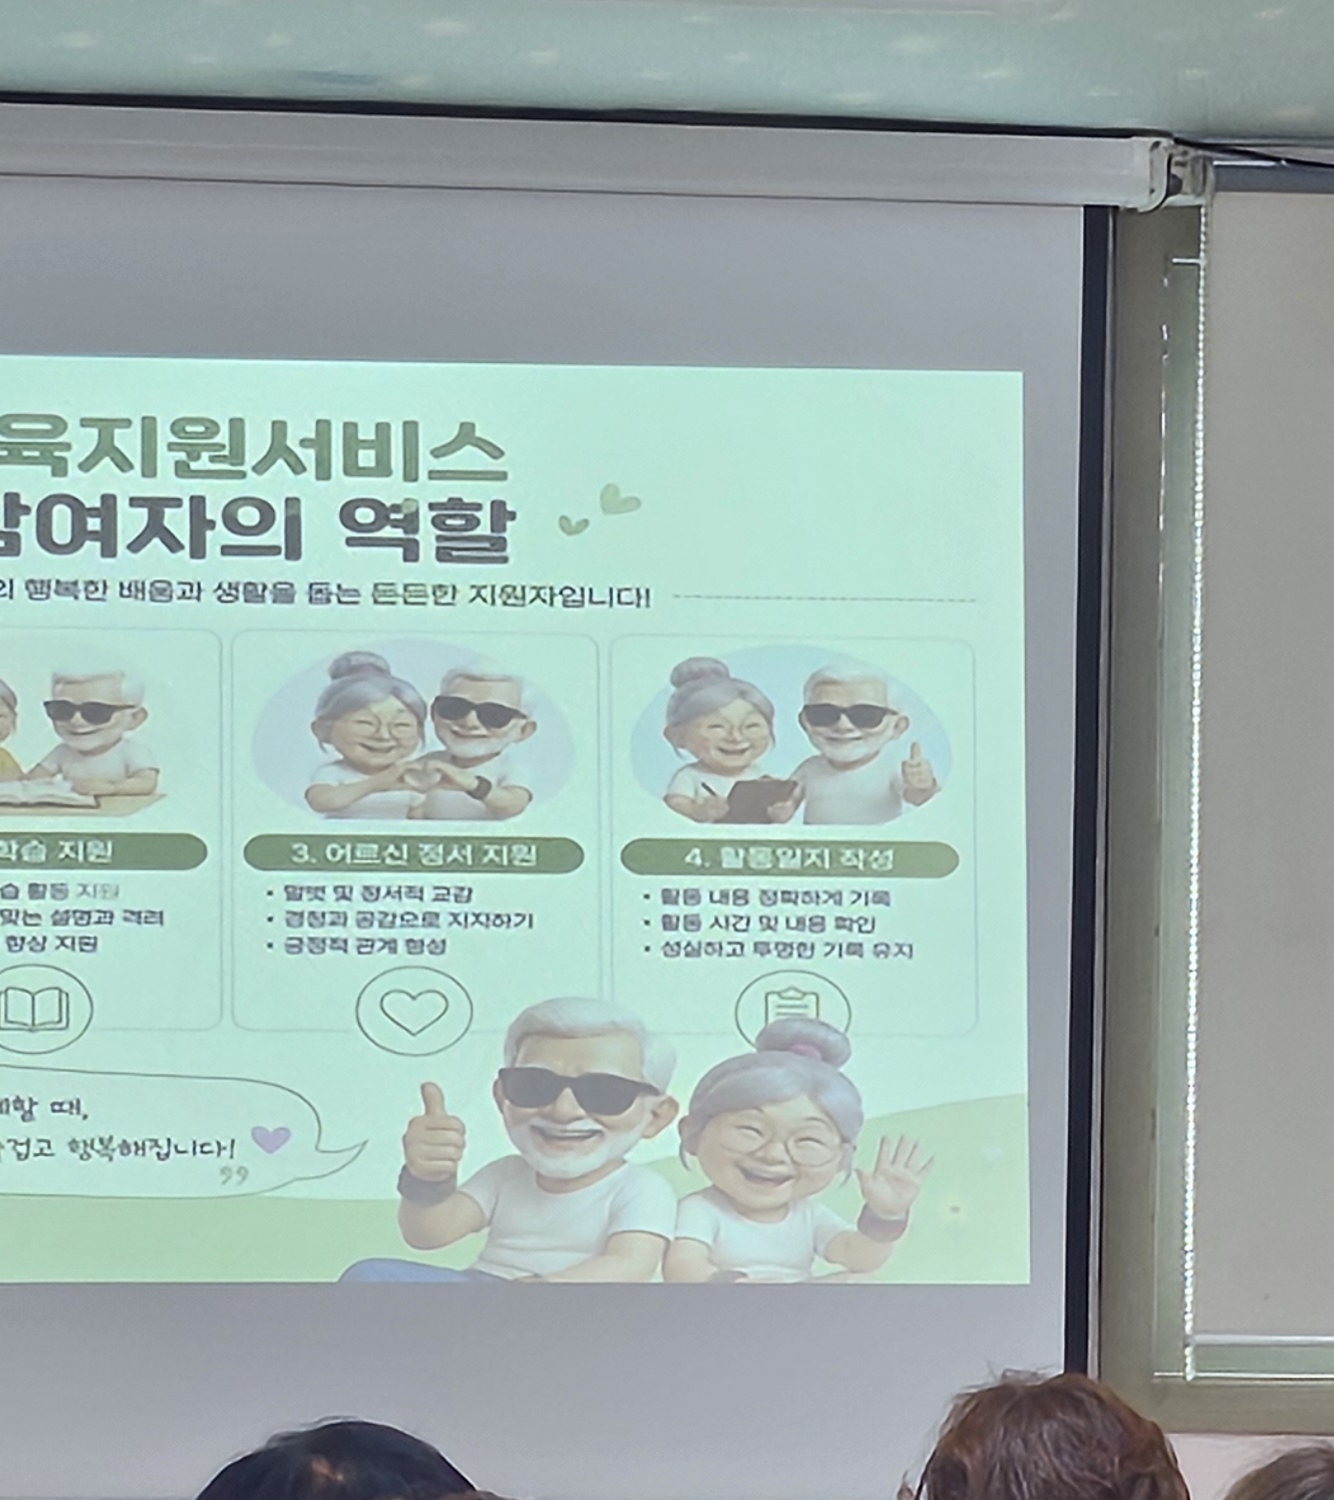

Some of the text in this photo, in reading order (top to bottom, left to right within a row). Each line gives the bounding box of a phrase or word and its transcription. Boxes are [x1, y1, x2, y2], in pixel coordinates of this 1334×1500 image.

[338, 496, 518, 565] 역할
[25, 577, 109, 602] 행복한
[118, 580, 202, 604] 배움과
[213, 581, 296, 605] 생활을
[307, 583, 361, 606] 돕는
[371, 583, 458, 608] 든든한
[469, 584, 652, 609] 지원자입니다!
[57, 840, 114, 864] 지원
[290, 843, 539, 867] 3. 어르신 정서 지원
[683, 848, 711, 869] 4.
[840, 848, 896, 872] 작성
[67, 1134, 236, 1163] 행복해집니다!
